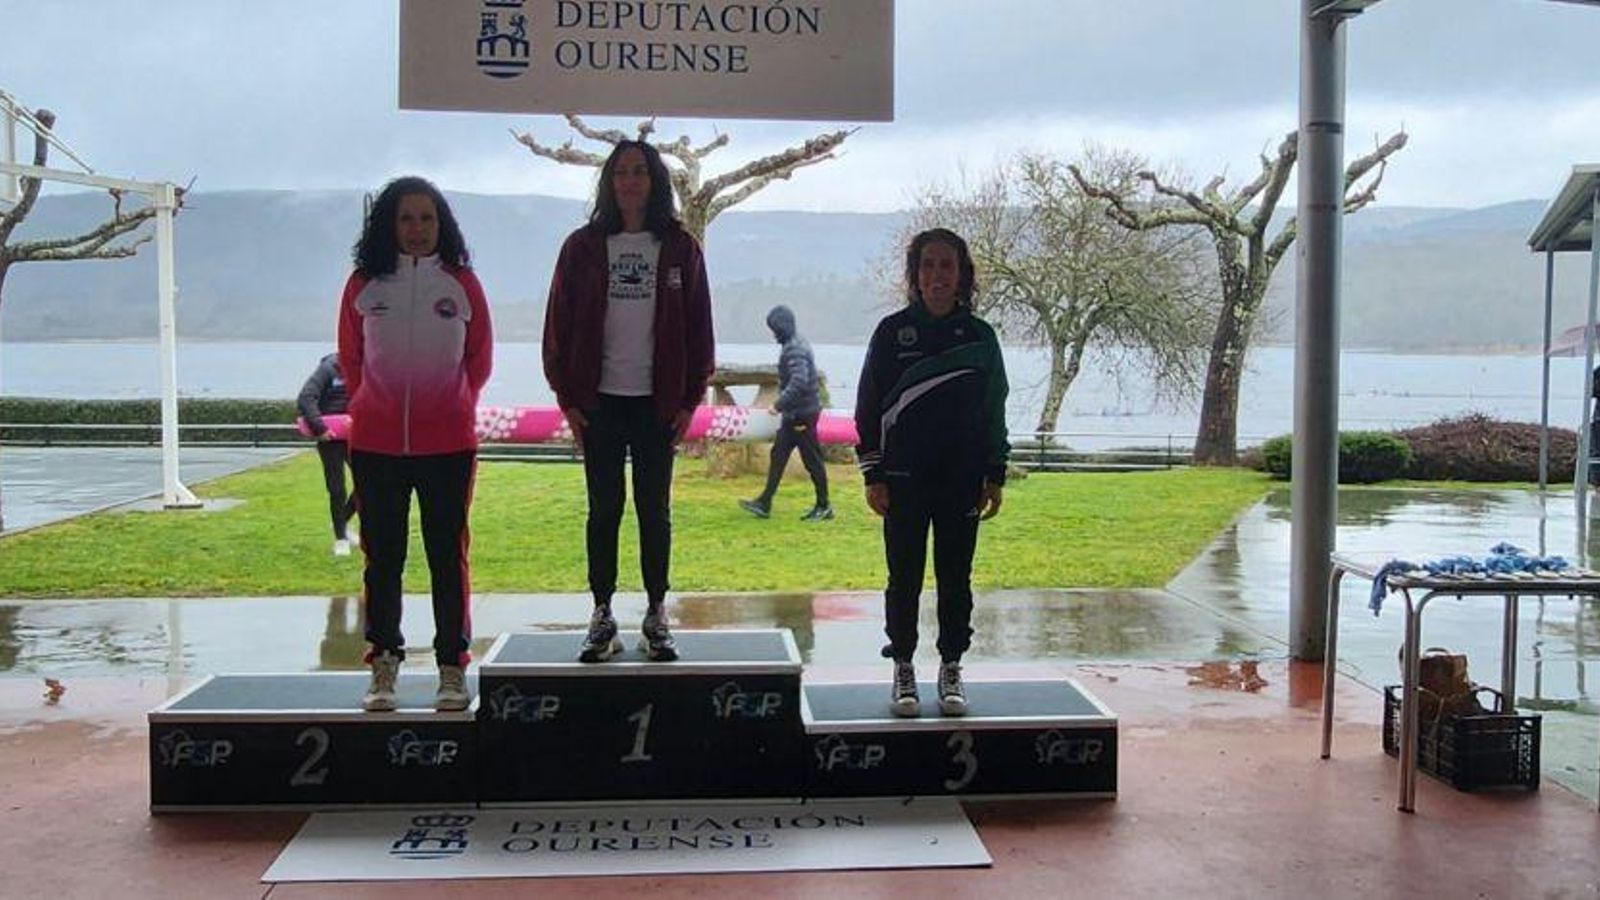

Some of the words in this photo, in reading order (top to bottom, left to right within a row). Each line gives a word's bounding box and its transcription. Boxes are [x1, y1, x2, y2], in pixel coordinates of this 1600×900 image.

[555, 0, 821, 34] DEPUTACIÓN
[555, 40, 749, 73] OURENSE
[621, 703, 653, 763] 1
[290, 727, 331, 787] 2
[945, 731, 978, 791] 3
[510, 812, 865, 834] DEPUTACIÓN
[502, 833, 773, 853] OURENSE
